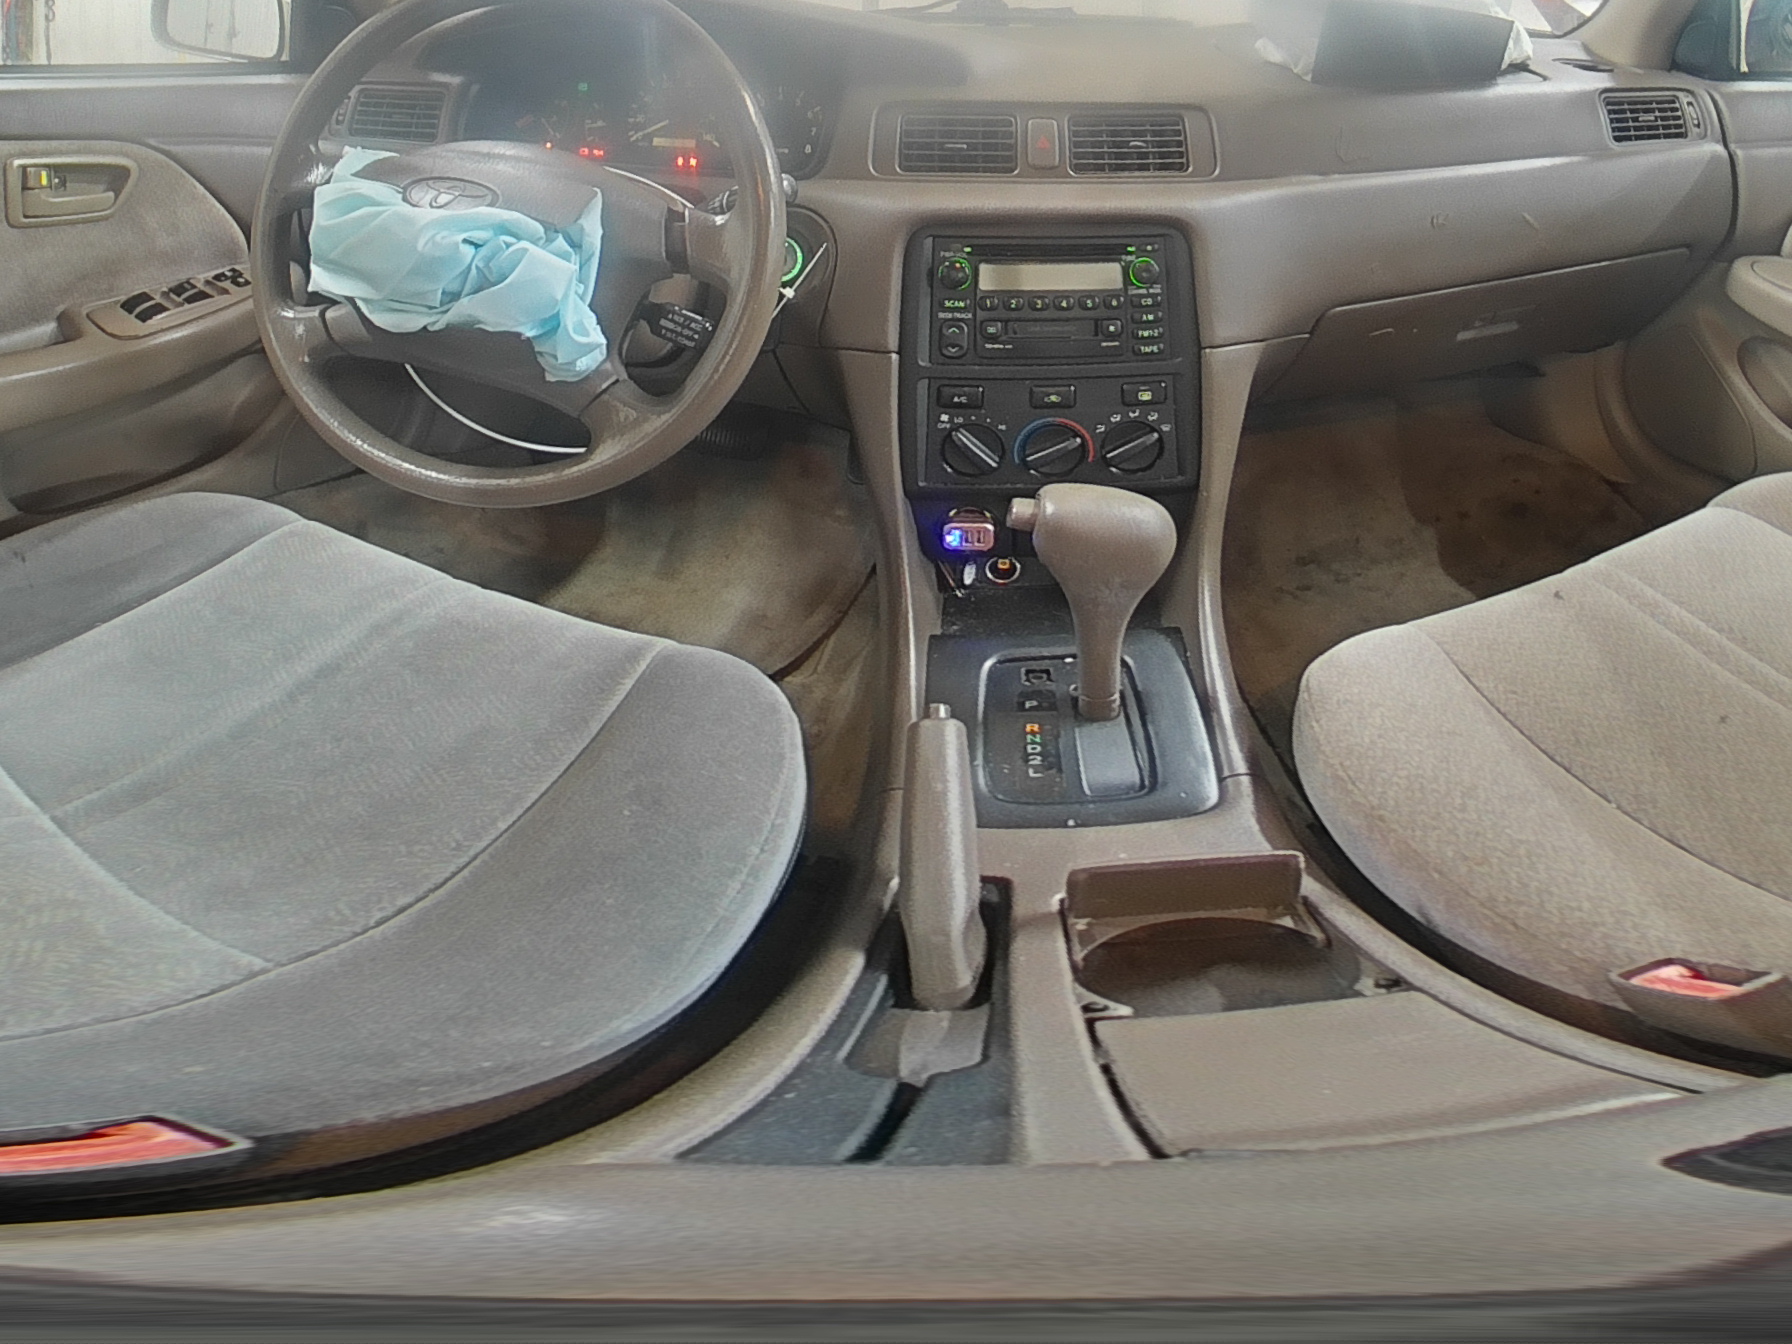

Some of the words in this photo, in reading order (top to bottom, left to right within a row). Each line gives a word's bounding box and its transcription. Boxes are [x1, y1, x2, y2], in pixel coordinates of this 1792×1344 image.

[943, 299, 966, 308] SCAN
[1139, 345, 1159, 354] TAPE
[953, 395, 967, 403] A/C
[1024, 700, 1038, 709] P
[1025, 723, 1040, 732] R
[1026, 733, 1042, 742] N
[1026, 744, 1042, 753] D
[1028, 767, 1044, 777] L
